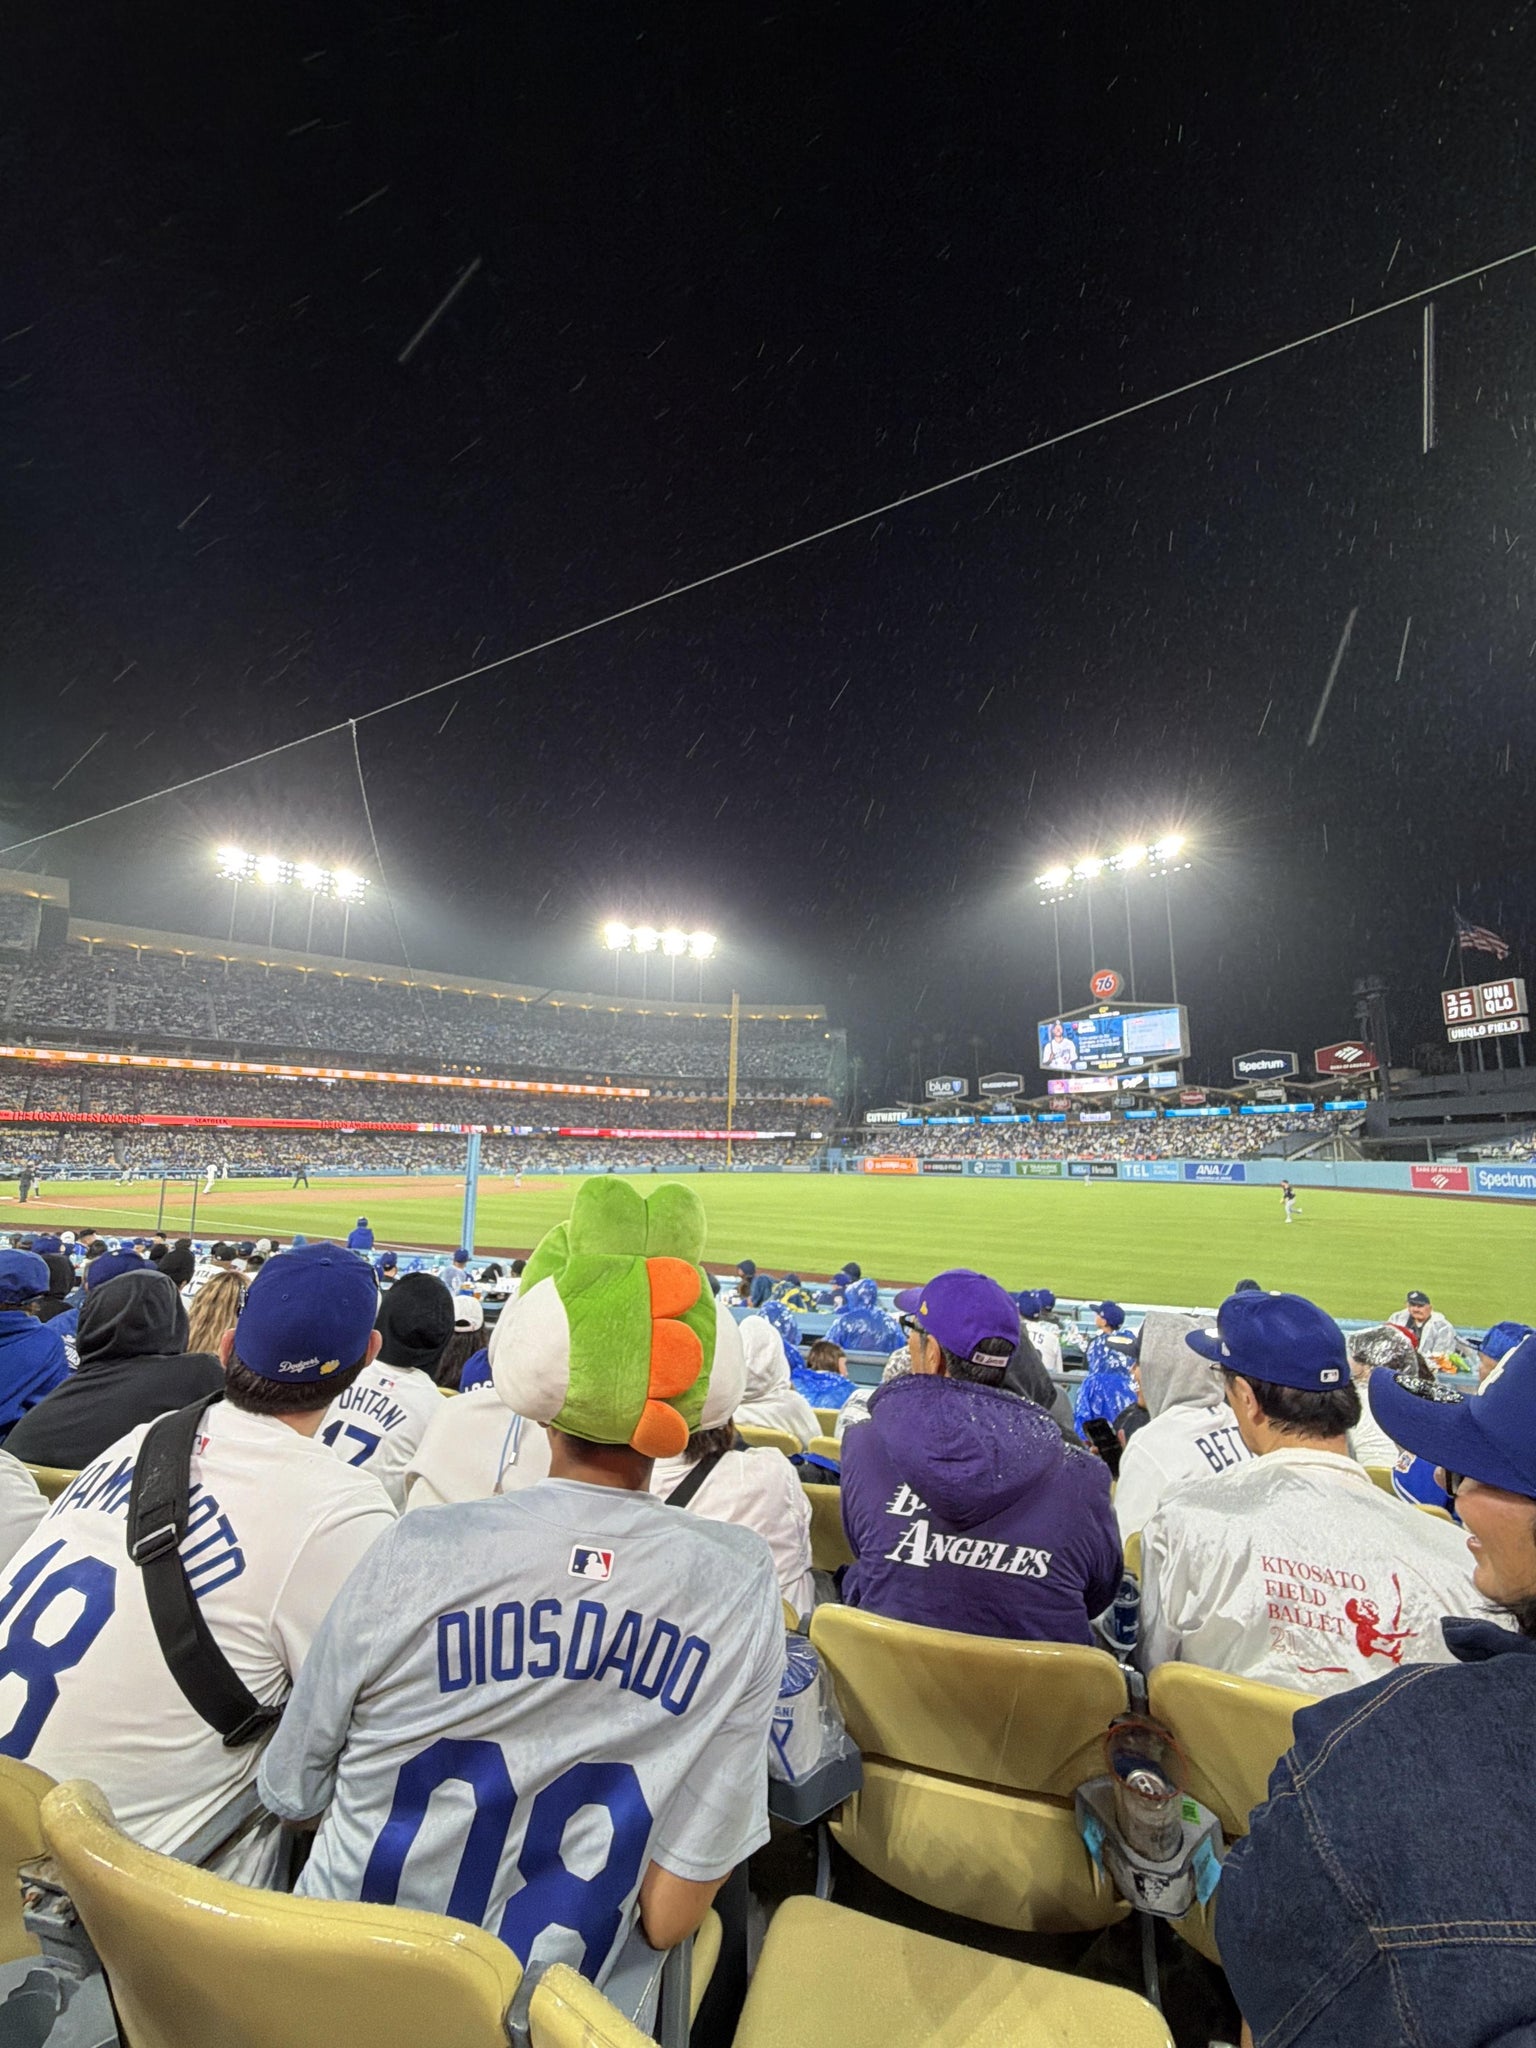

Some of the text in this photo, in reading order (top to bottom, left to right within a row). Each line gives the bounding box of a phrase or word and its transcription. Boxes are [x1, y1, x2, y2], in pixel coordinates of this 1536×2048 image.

[1097, 976, 1114, 991] 76
[1483, 984, 1510, 1000] UNI
[1485, 997, 1514, 1014] QLO
[1451, 1020, 1519, 1040] UNIQLO FIELD
[1238, 1059, 1284, 1073] Spectrum
[929, 1080, 951, 1092] blue
[866, 1112, 908, 1123] CUTWATER
[1091, 1165, 1115, 1175] Health
[1125, 1164, 1149, 1177] TEL
[1196, 1164, 1220, 1175] ANA
[1479, 1171, 1536, 1189] Spectrum
[278, 1356, 320, 1373] Dodgers
[339, 1386, 407, 1432] OHTANI
[322, 1420, 382, 1467] 17
[1195, 1426, 1254, 1473] BETT
[884, 1519, 1052, 1578] ANGELES
[1261, 1556, 1367, 1592] KIYOSATO
[1264, 1579, 1327, 1607] FIELD
[1268, 1602, 1346, 1636] BALLET
[437, 1598, 711, 1716] DIOSDADO
[360, 1736, 654, 1986] 08
